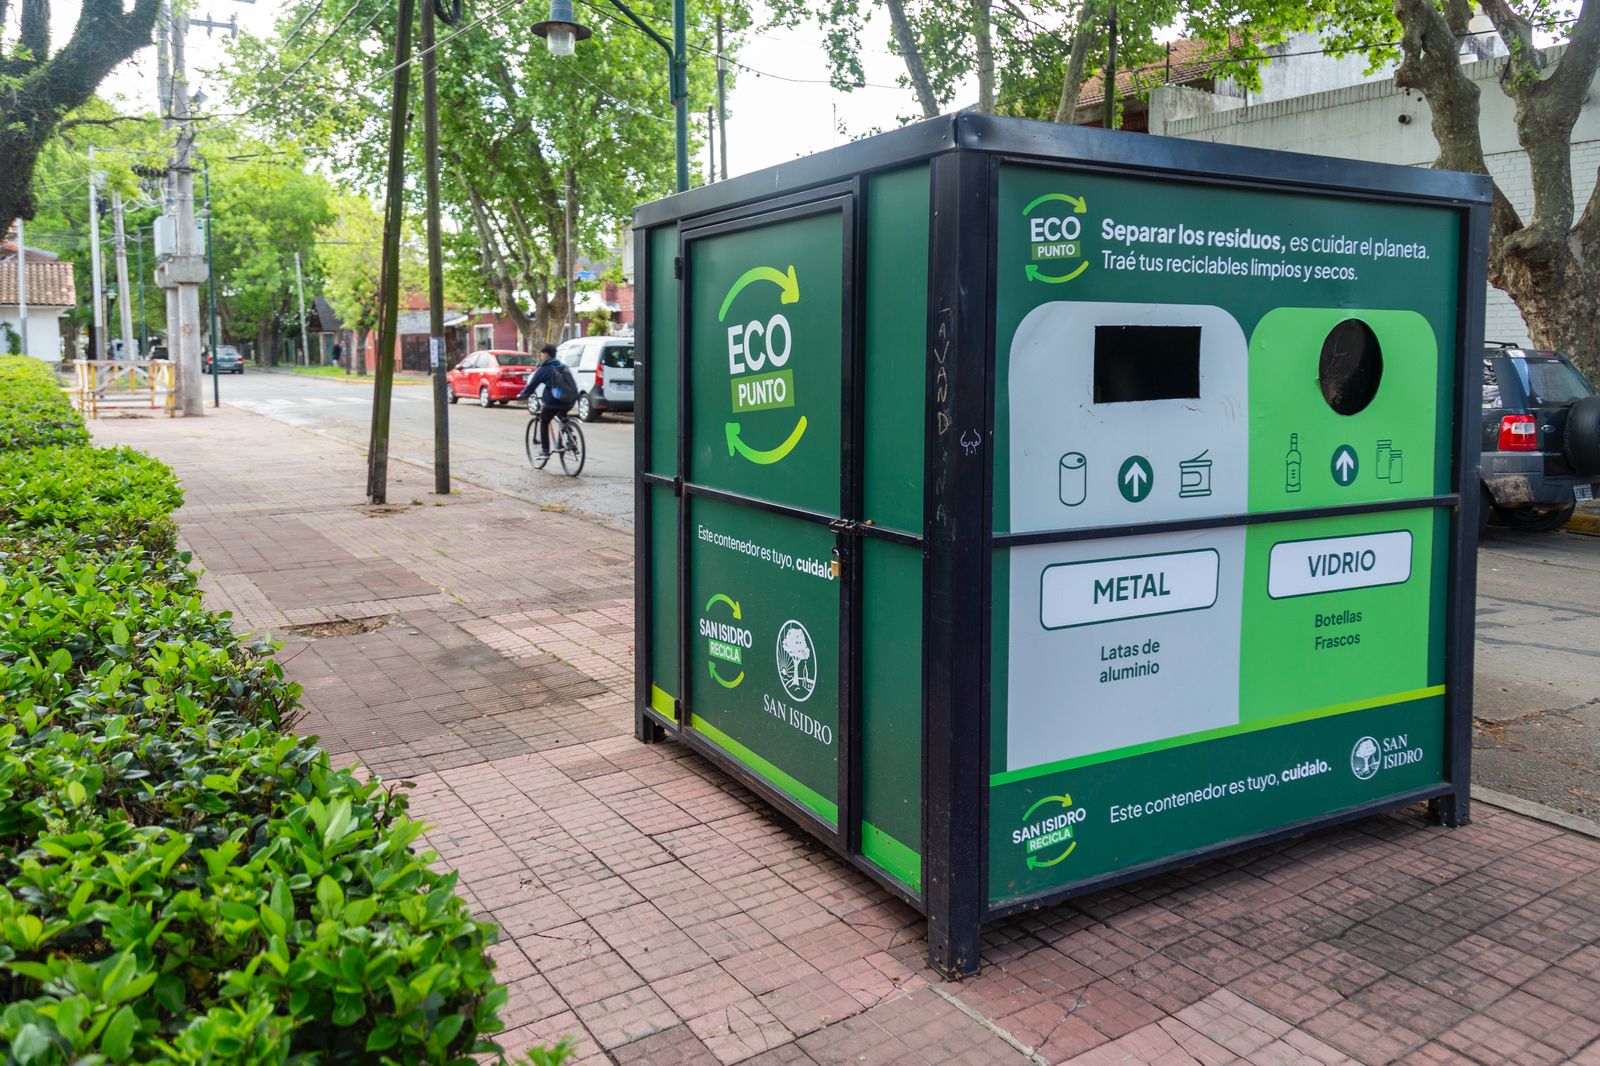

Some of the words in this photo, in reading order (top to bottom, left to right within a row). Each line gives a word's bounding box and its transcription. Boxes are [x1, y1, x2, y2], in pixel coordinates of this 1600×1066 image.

[1030, 216, 1081, 242] ECO
[1101, 218, 1176, 246] Separar
[1178, 224, 1204, 246] los
[1207, 227, 1286, 254] residuos,
[1289, 236, 1309, 252] es
[1311, 234, 1359, 255] cuidar
[1360, 237, 1373, 256] el
[1374, 238, 1430, 260] planeta.
[1037, 244, 1075, 258] PUNTO
[1101, 250, 1136, 271] Traé
[1139, 253, 1164, 272] tus
[1166, 255, 1249, 275] reciclables
[1250, 258, 1302, 281] limpios
[1302, 265, 1313, 283] y
[1314, 265, 1359, 280] secos.
[727, 313, 792, 375] ECO
[738, 377, 787, 407] PUNTO
[698, 524, 714, 543] Este
[713, 534, 761, 557] contenedor
[760, 547, 771, 561] es
[772, 549, 795, 571] tuyo,
[1308, 549, 1376, 578] VIDRIO
[1093, 572, 1171, 605] METAL
[699, 618, 718, 640] SAN
[718, 622, 753, 649] ISIDRO
[1314, 609, 1362, 629] Botellas
[709, 641, 740, 663] RECICLA
[1100, 641, 1139, 662] Latas
[1141, 638, 1160, 656] de
[1314, 632, 1361, 651] Frascos
[1099, 659, 1160, 684] aluminio
[763, 693, 786, 722] SAN
[789, 707, 832, 745] ISIDRO
[1383, 733, 1408, 752] SAN
[1383, 747, 1423, 770] ISIDRO
[1110, 804, 1142, 824] Este
[1145, 783, 1228, 815] contenedor
[1229, 779, 1245, 795] es
[1247, 772, 1280, 792] tuyo,
[1281, 758, 1332, 783] cuidalo.
[1012, 824, 1040, 844] SAN
[1042, 807, 1086, 834] ISIDRO
[1029, 828, 1072, 851] RECICLA
